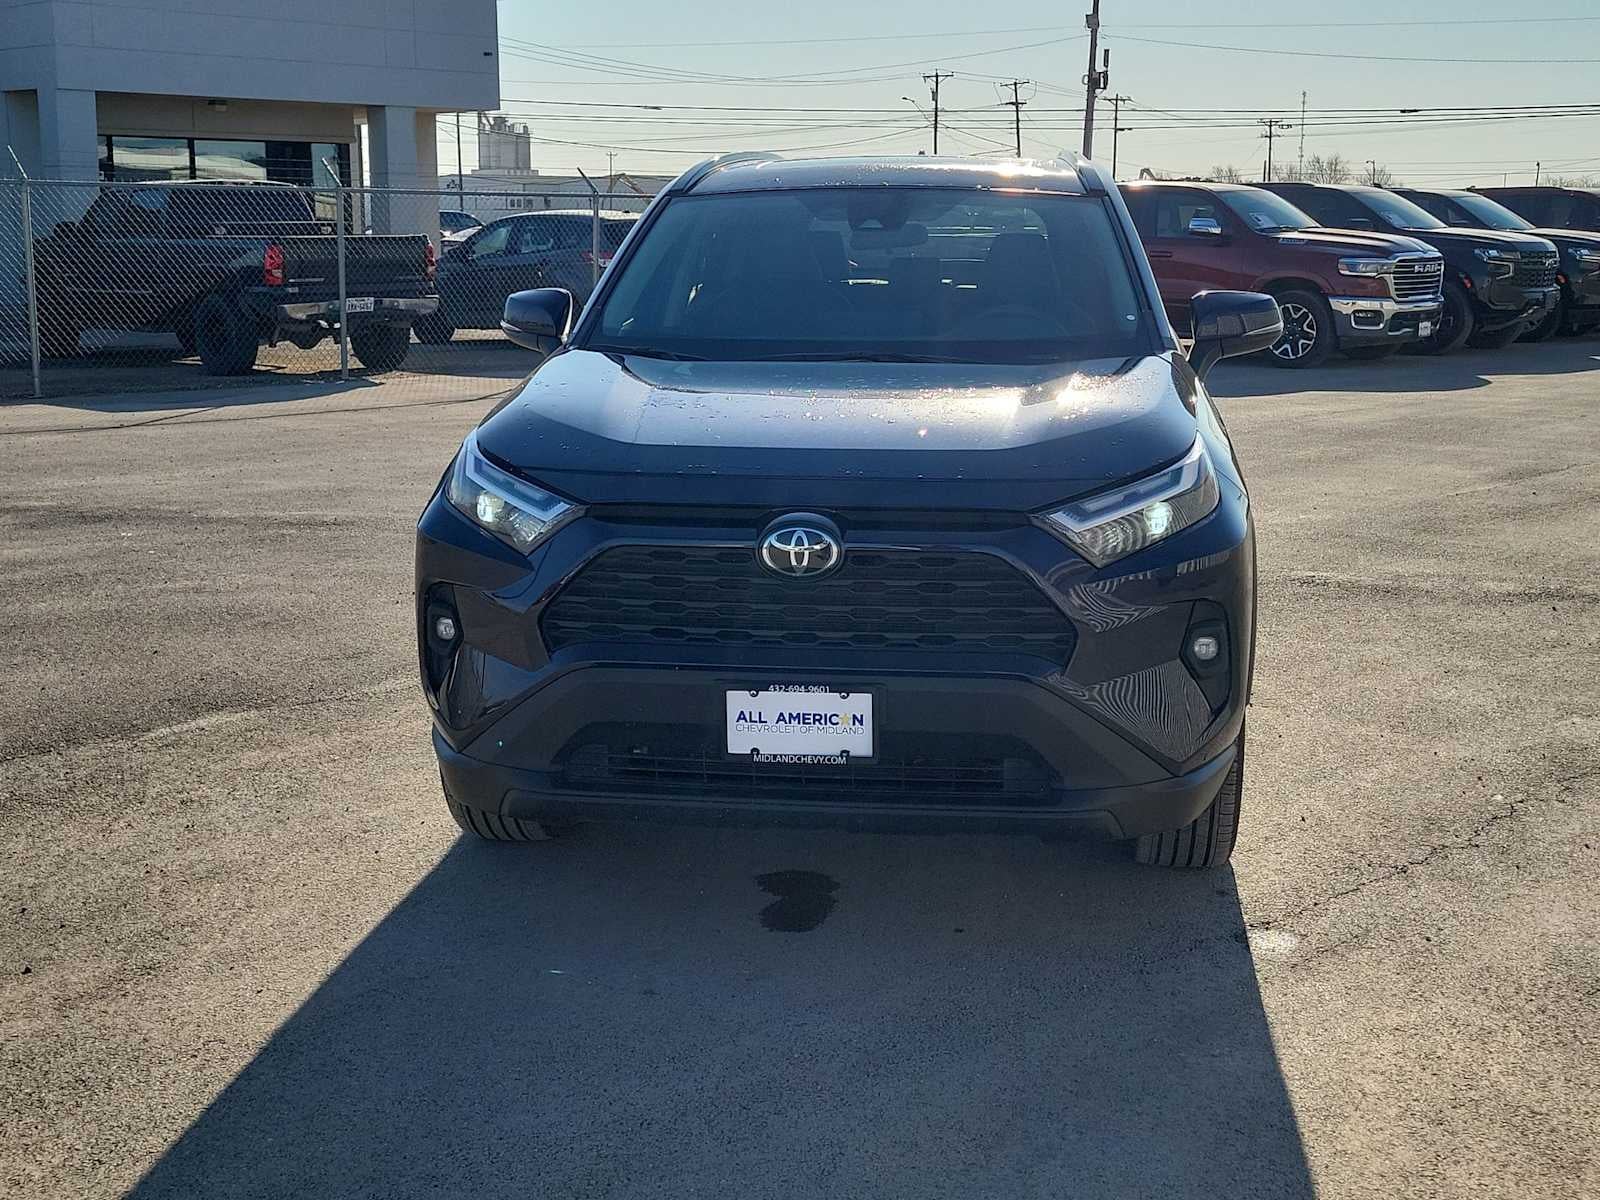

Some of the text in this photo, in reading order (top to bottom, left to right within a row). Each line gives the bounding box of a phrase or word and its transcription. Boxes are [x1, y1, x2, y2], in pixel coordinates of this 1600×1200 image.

[768, 684, 830, 694] 432-694-9601
[735, 710, 864, 726] ALL AMERICN
[735, 723, 865, 736] CHEVROLET OF MIDLAND
[752, 753, 847, 765] MIDLANDCHEVY.COM
